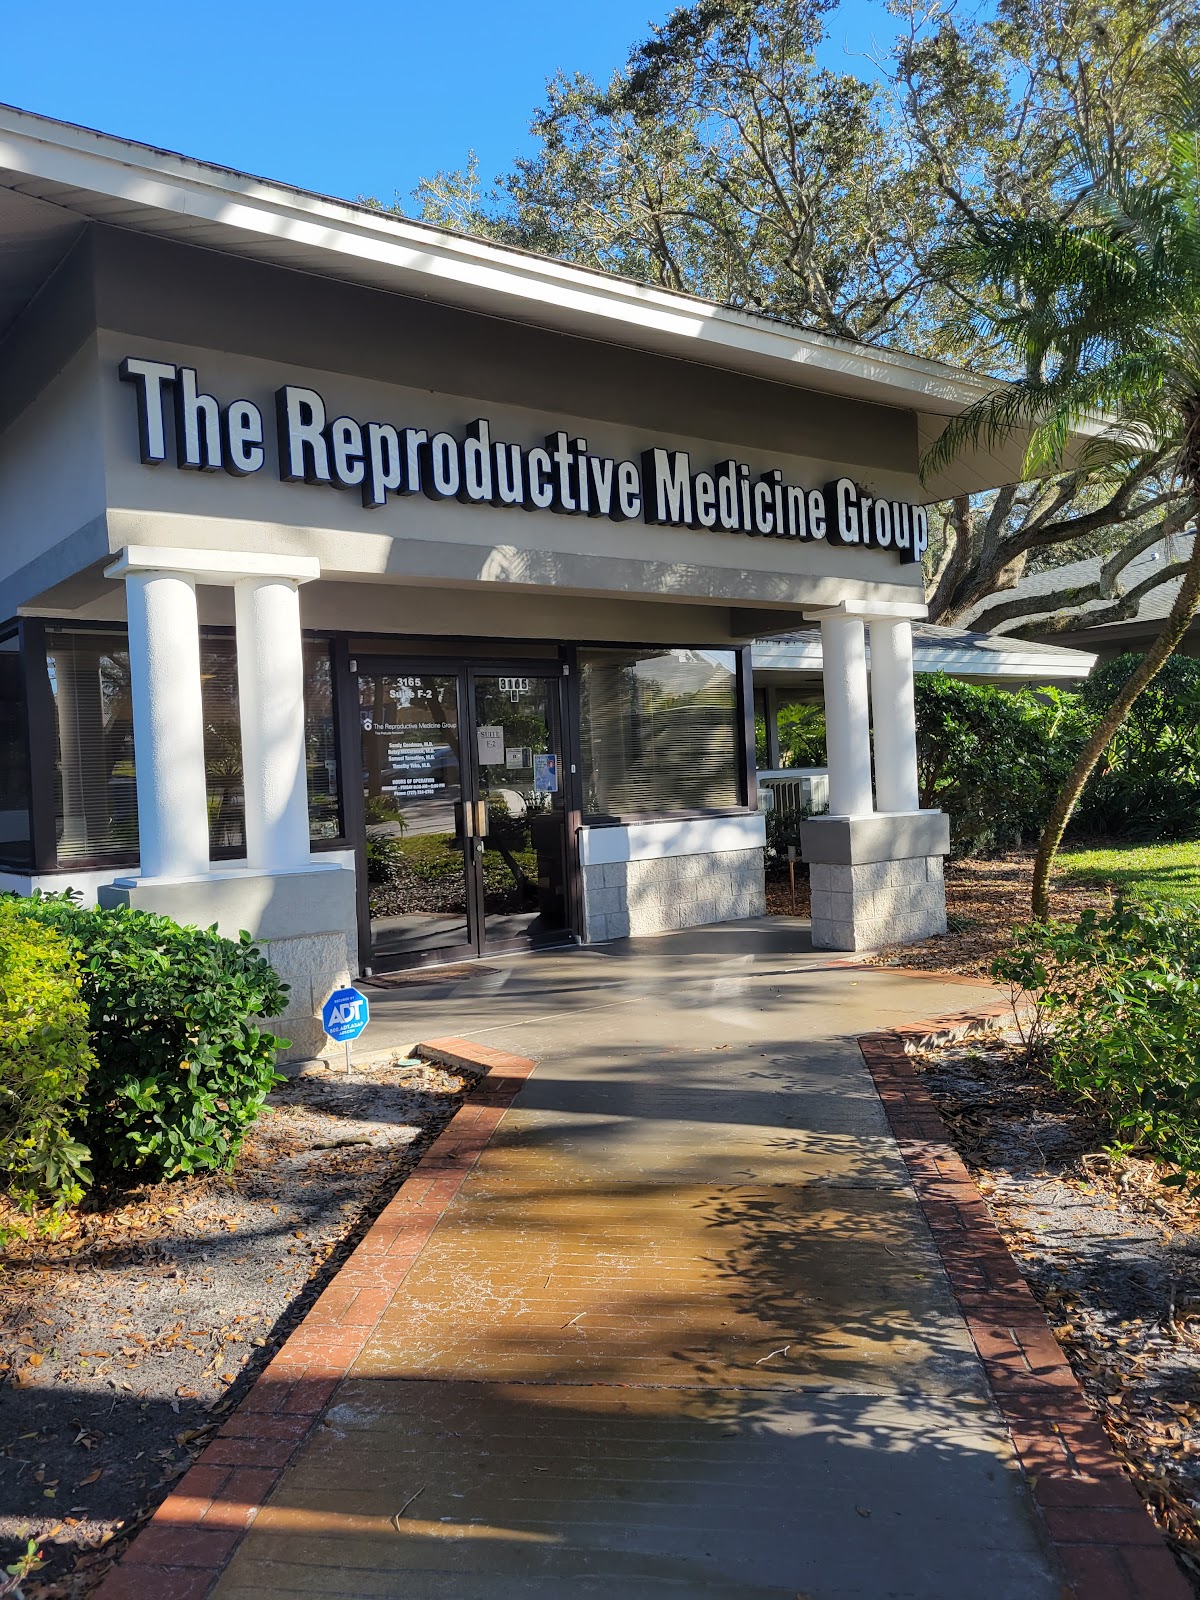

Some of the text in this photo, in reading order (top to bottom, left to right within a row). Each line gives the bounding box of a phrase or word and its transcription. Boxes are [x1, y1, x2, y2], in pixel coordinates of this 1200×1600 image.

[120, 356, 928, 563] The Reproductive Medicine Group
[397, 678, 421, 686] 3165
[500, 679, 527, 689] 3165
[418, 690, 432, 698] F-2
[385, 722, 418, 730] Reproductive
[328, 1000, 363, 1027] ADT
